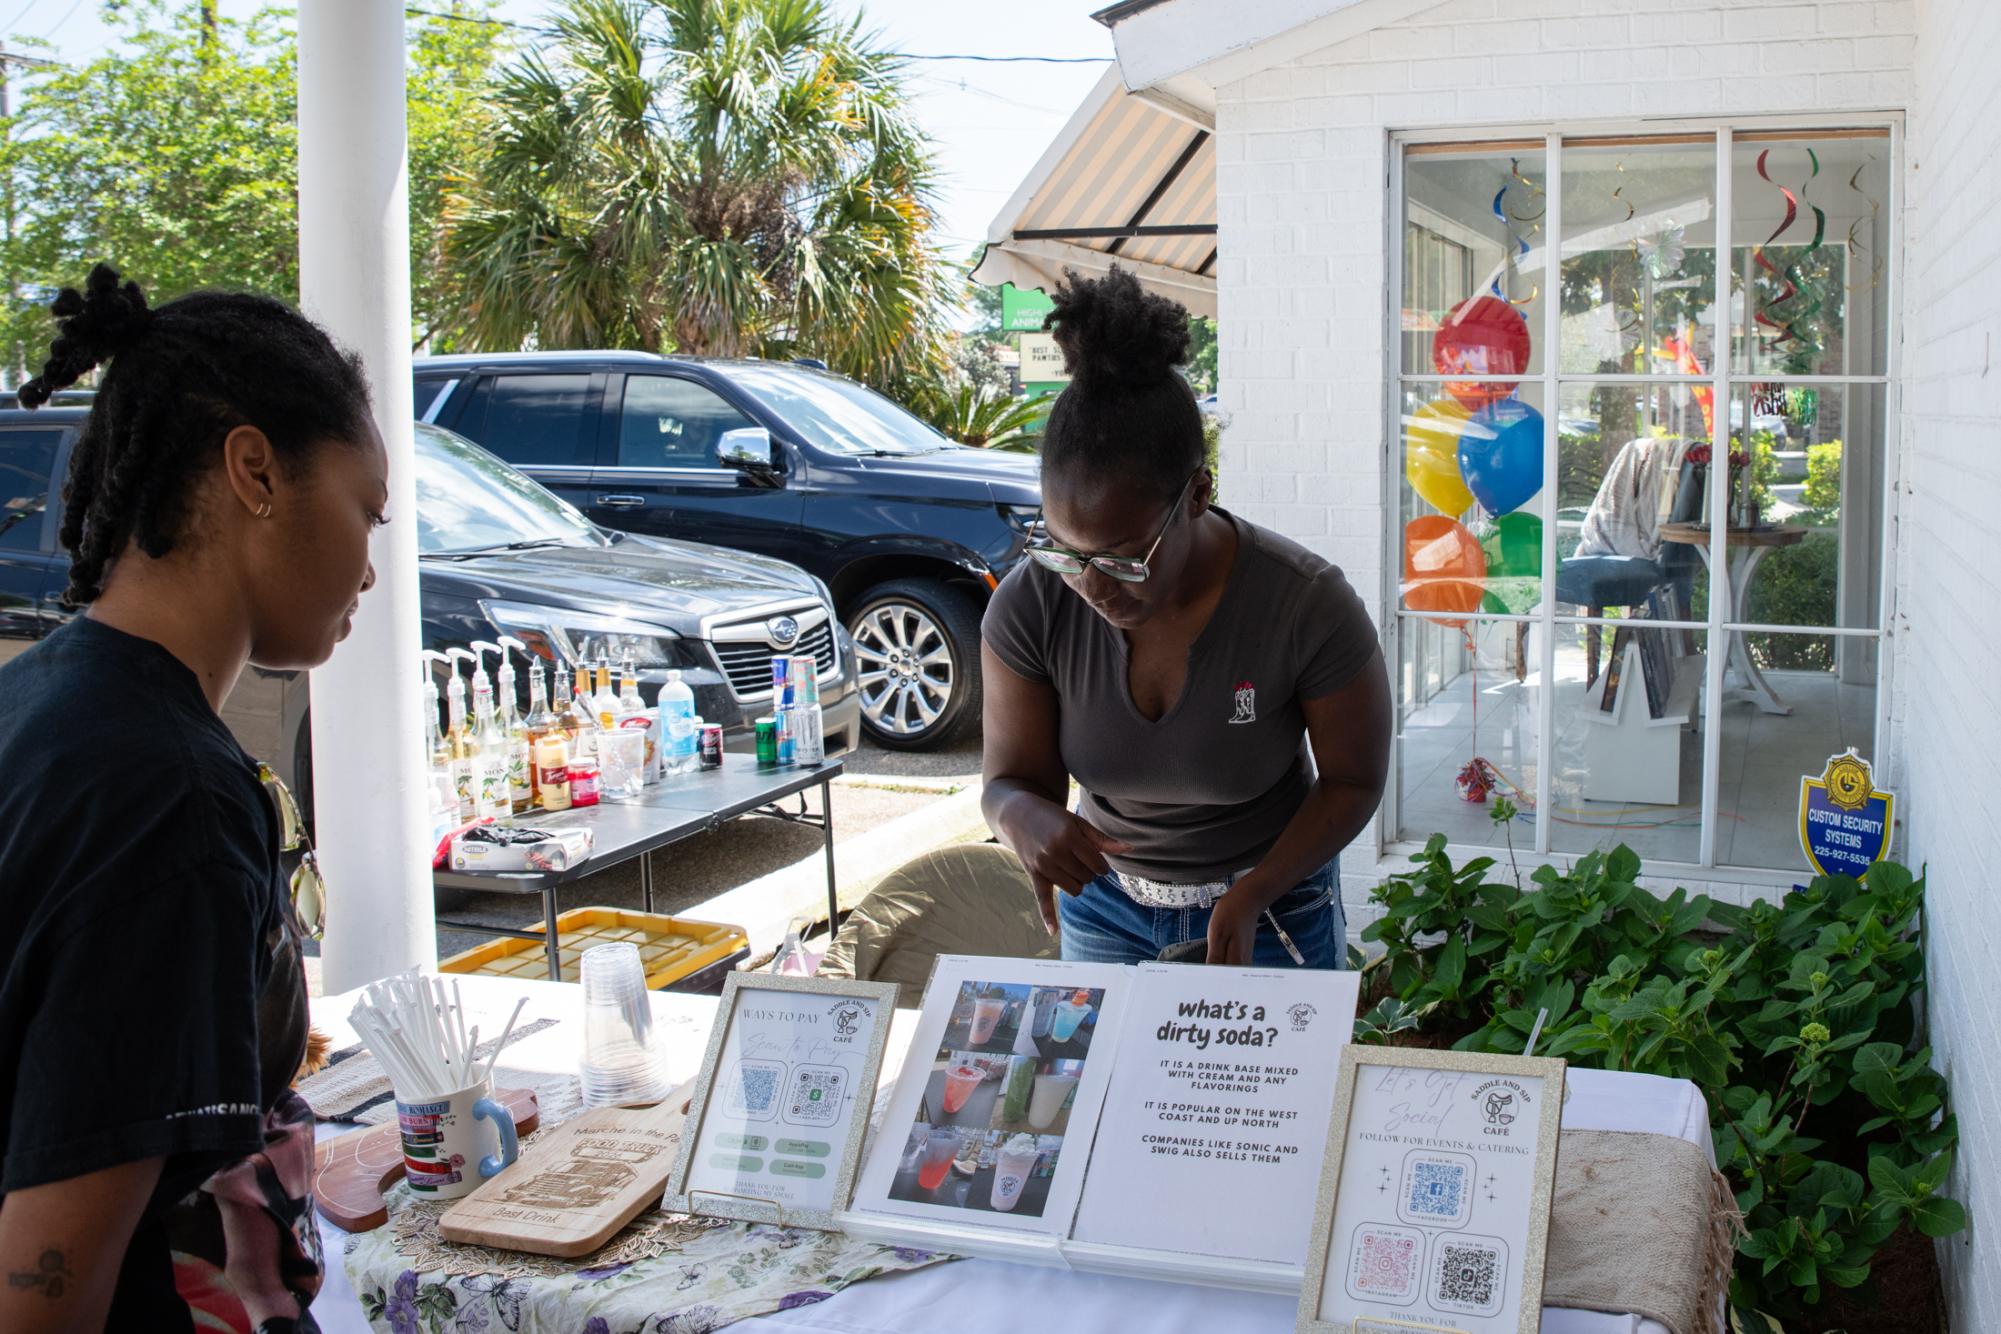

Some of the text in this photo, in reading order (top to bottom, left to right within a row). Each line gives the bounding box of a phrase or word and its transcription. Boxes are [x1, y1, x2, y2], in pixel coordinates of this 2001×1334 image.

[1808, 808, 1883, 835] CUSTOM SECURITY
[1825, 829, 1862, 848] SYSTEMS
[1814, 845, 1871, 866] 225-927-5535
[744, 1008, 822, 1024] WAYS TO PAY
[827, 1000, 850, 1016] SADDLE
[851, 1000, 864, 1009] AND
[1252, 1006, 1265, 1022] a
[1157, 1021, 1278, 1050] dirty soda?
[1160, 1060, 1169, 1068] IT
[1174, 1060, 1182, 1069] IS
[1198, 1062, 1230, 1072] DRINK
[1234, 1065, 1261, 1074] BASE
[1265, 1066, 1298, 1076] MIXED
[1168, 1070, 1287, 1085] WITH CREAM AND ANY
[1191, 1082, 1259, 1093] FLAVORINGS
[1471, 1079, 1531, 1103] SADDLE AND SIP
[1145, 1101, 1298, 1120] IT IS POPULAR ON THE WEST
[1159, 1112, 1279, 1128] COAST AND UP NORTH
[645, 1129, 664, 1138] the
[1142, 1134, 1298, 1154] COMPANIES LIKE SONIC AND
[1359, 1132, 1530, 1155] FOLLOW FOR EVENTS & CATERING
[1151, 1146, 1280, 1164] SWIG ALSO SELLS THEM
[492, 1206, 560, 1224] Best Drink
[1440, 1319, 1457, 1328] FOR
